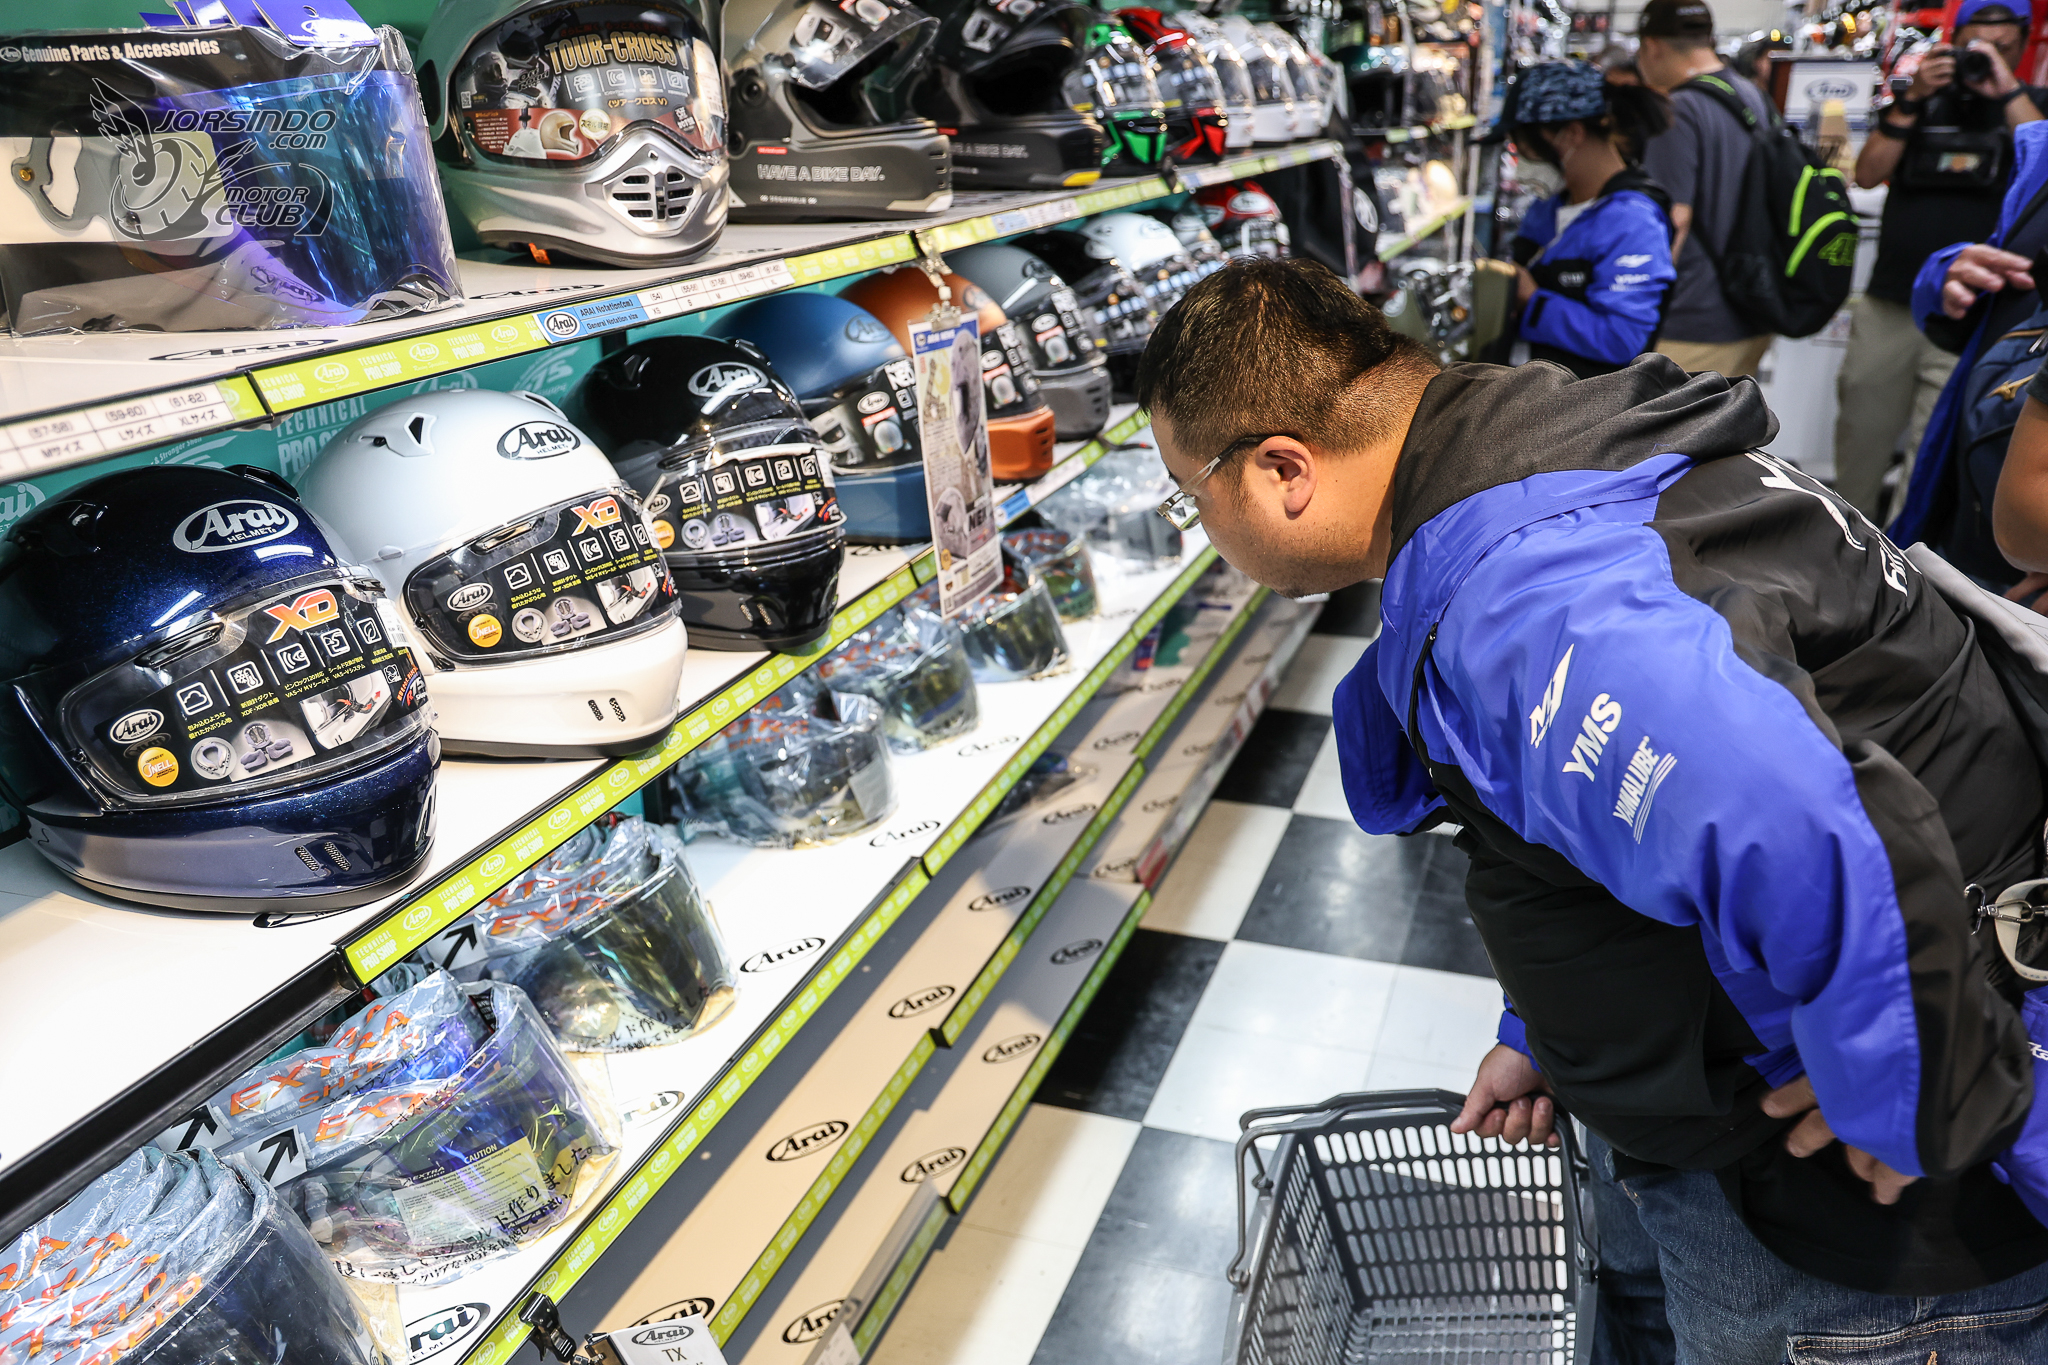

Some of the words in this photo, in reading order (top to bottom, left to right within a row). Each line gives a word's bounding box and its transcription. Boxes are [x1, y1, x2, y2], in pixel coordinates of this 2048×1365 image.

[22, 46, 71, 62] Genuine
[69, 45, 111, 61] Parts
[110, 46, 123, 60] &
[123, 39, 220, 59] Accessories
[545, 31, 677, 75] TOUR-CROSS
[757, 164, 797, 180] HAVE
[798, 166, 810, 180] A
[812, 167, 849, 181] BIKE
[850, 167, 885, 181] DAY.
[580, 306, 594, 317] ARAI
[650, 292, 663, 301] (54)
[553, 312, 574, 330] Arai
[586, 320, 607, 330] General
[607, 316, 628, 327] Notation
[628, 313, 640, 322] size
[495, 327, 517, 341] Arai
[358, 351, 397, 367] TECHNICAL
[415, 345, 438, 360] Arai
[453, 347, 468, 361] PRO
[468, 342, 486, 358] SHOP
[259, 371, 300, 389] ECHNICAL
[320, 365, 347, 382] Arai
[363, 366, 381, 381] PRO
[381, 361, 403, 378] SHOP
[169, 391, 208, 408] (61-62)
[283, 384, 306, 402] SHOP
[118, 424, 155, 442] Lサイズ
[178, 410, 218, 427] XLサイズ
[509, 426, 572, 458] Arai
[192, 504, 284, 546] Arai
[571, 497, 621, 536] XD
[227, 529, 277, 543] HELMET
[454, 586, 485, 608] Arai
[264, 589, 341, 644] XD
[118, 712, 156, 740] Arai
[1562, 692, 1622, 782] YMS
[142, 760, 174, 778] SNELL
[612, 770, 628, 786] Arai
[1613, 742, 1660, 827] YAMALUBE
[580, 801, 593, 816] PRO
[593, 793, 606, 809] SHOP
[552, 811, 570, 827] Arai
[511, 828, 540, 850] TECHNICAL
[515, 845, 530, 862] PRO
[529, 835, 544, 853] SHOP
[483, 857, 503, 874] Arai
[438, 876, 470, 900] TECHNICAL
[443, 896, 459, 913] PRO
[458, 884, 475, 903] SHOP
[407, 908, 428, 928] Arai
[355, 930, 392, 958] TECHNICAL
[360, 952, 379, 971] PRO
[378, 939, 397, 959] SHOP
[780, 1121, 839, 1158] Arai
[464, 1143, 498, 1164] CAUTION
[914, 1150, 957, 1176] Arai
[412, 1166, 446, 1181] EXTRA
[565, 1234, 592, 1262] TECHNICAL
[568, 1256, 583, 1273] PRO
[581, 1241, 597, 1261] SHOP
[409, 1304, 474, 1352] rai
[504, 1324, 518, 1343] PRO
[650, 1325, 686, 1342] Arai
[661, 1347, 687, 1362] TX
